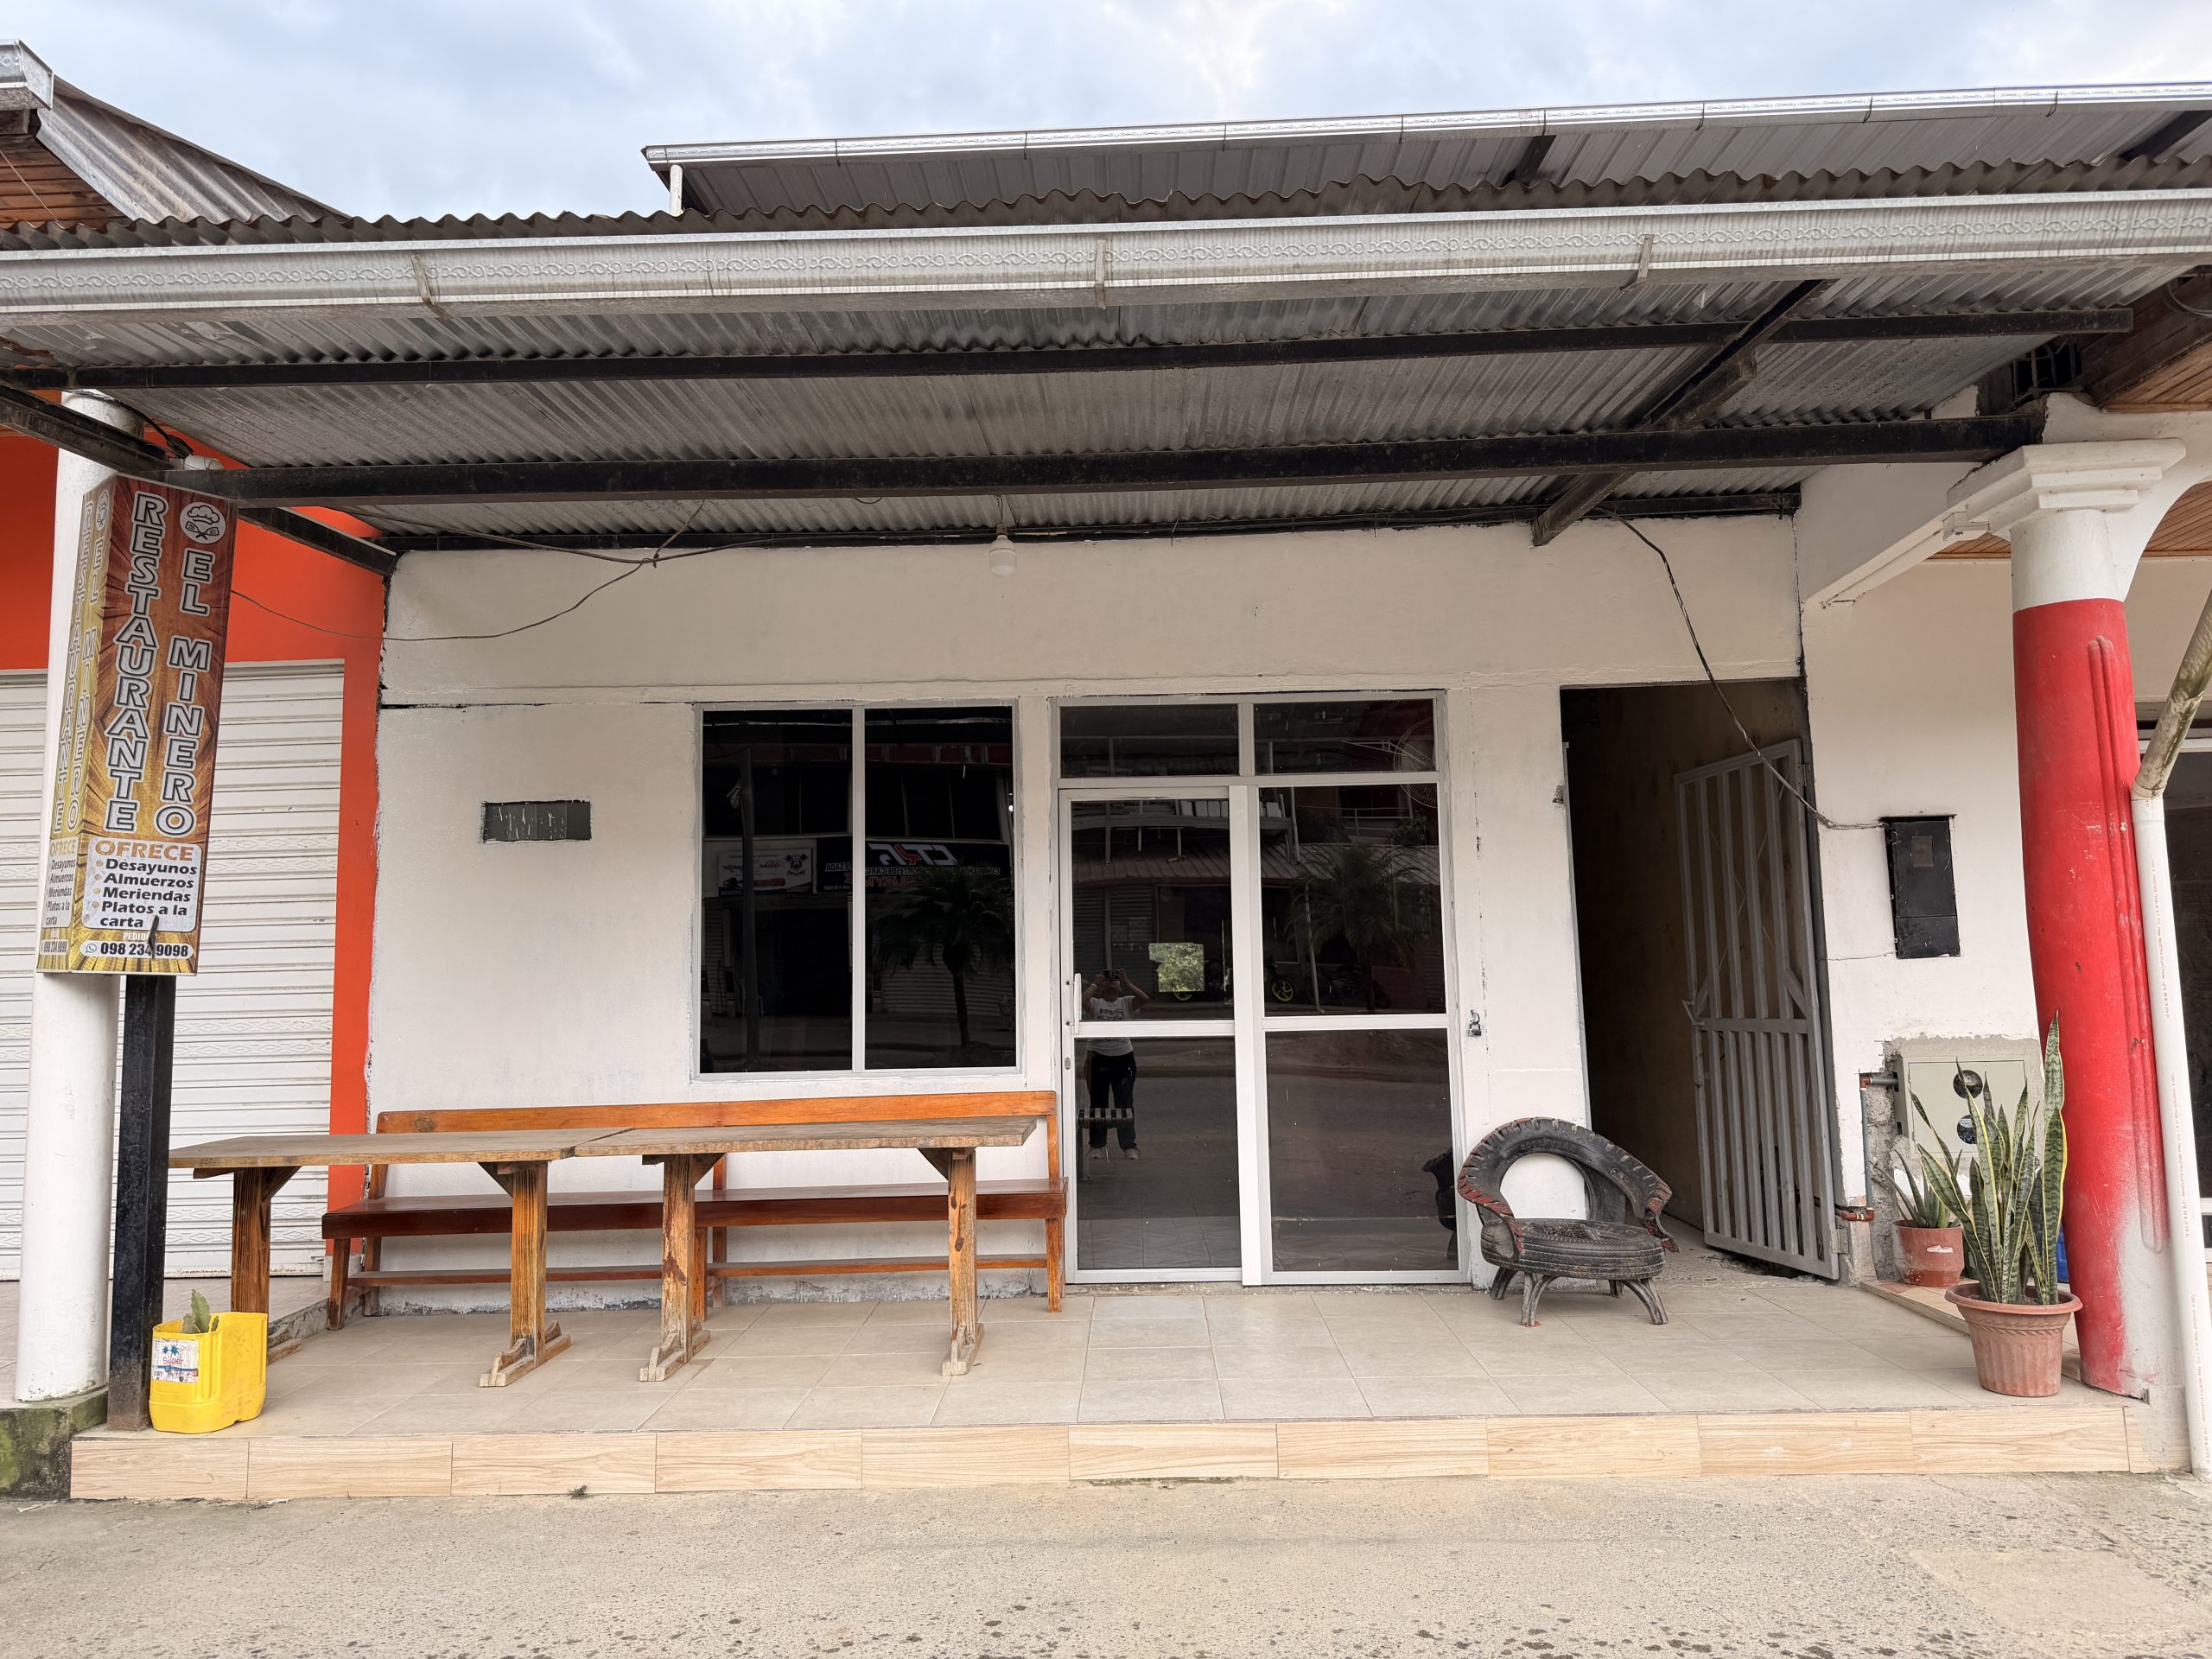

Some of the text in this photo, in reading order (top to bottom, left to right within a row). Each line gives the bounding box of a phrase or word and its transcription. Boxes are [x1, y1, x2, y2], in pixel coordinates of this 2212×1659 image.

[54, 499, 94, 833] RESTAURANTE
[103, 491, 168, 832] RESTAURANTE
[67, 538, 104, 831] EL MINERO
[154, 547, 215, 838] EL MINERO
[50, 839, 77, 857] OFRECE
[95, 840, 194, 861] OFRECE
[105, 858, 198, 875] Desayunos
[103, 873, 194, 888] Almuerzos
[102, 887, 191, 902] Meriendas
[101, 900, 188, 916] Platos a la
[100, 917, 143, 928] carta
[100, 943, 126, 955] 098
[156, 944, 188, 957] 9098
